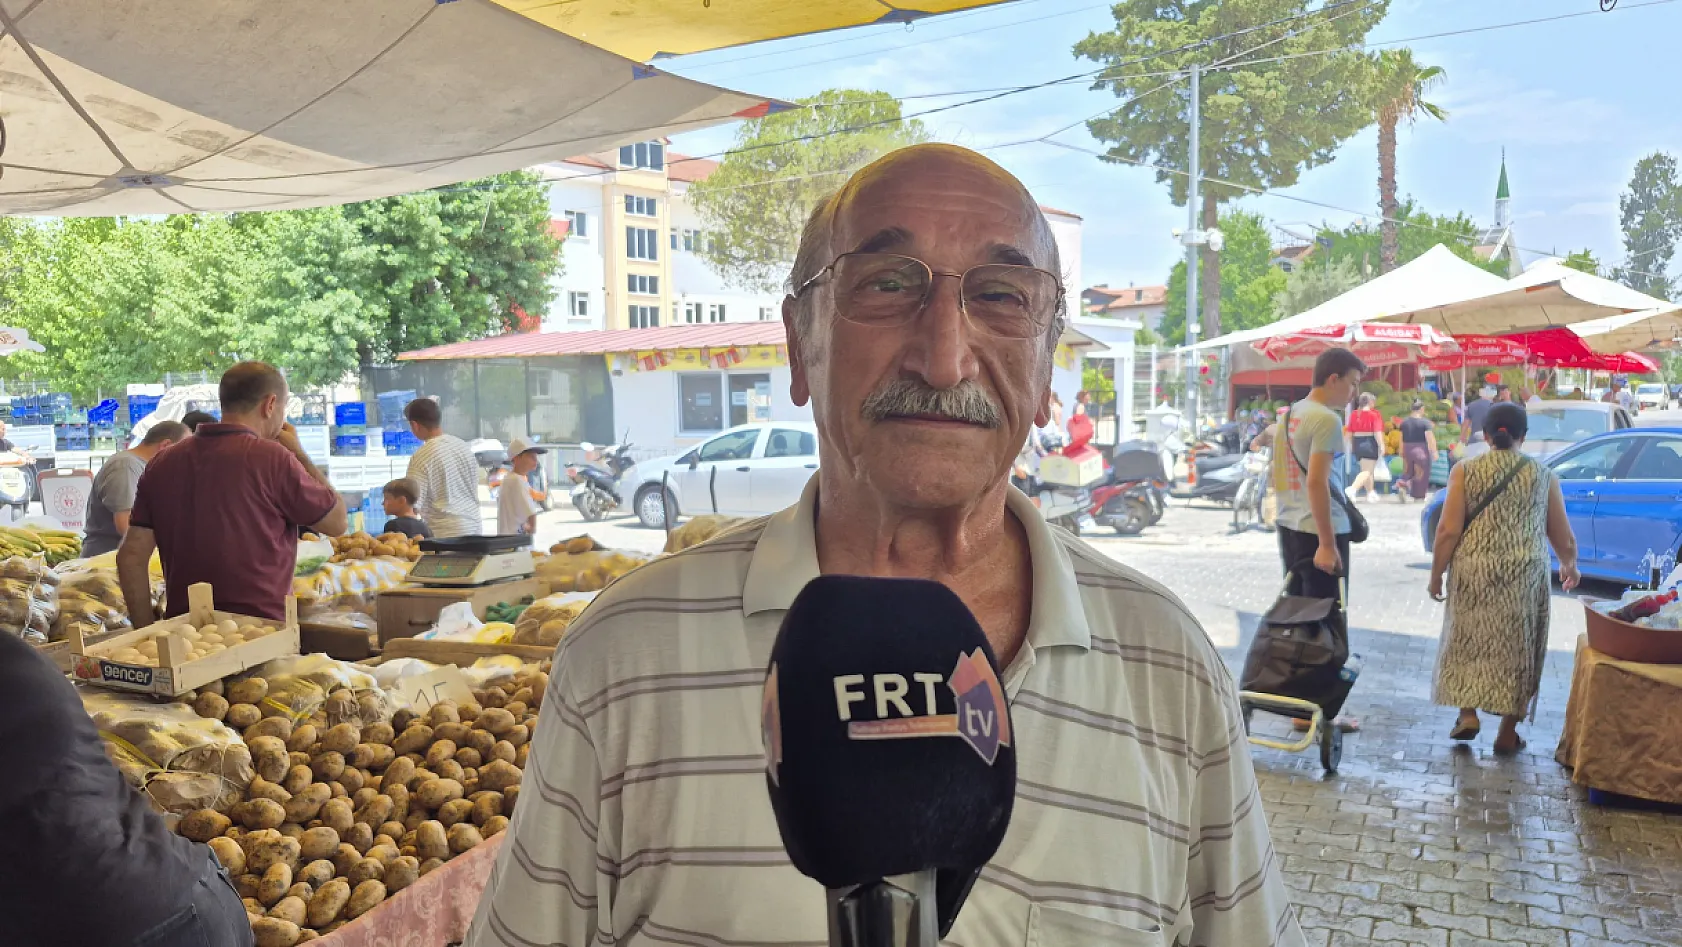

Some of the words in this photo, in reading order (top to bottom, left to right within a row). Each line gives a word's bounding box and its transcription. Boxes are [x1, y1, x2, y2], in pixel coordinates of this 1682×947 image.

[104, 664, 150, 683] gencer
[833, 672, 944, 721] FRT
[964, 701, 994, 737] tv
